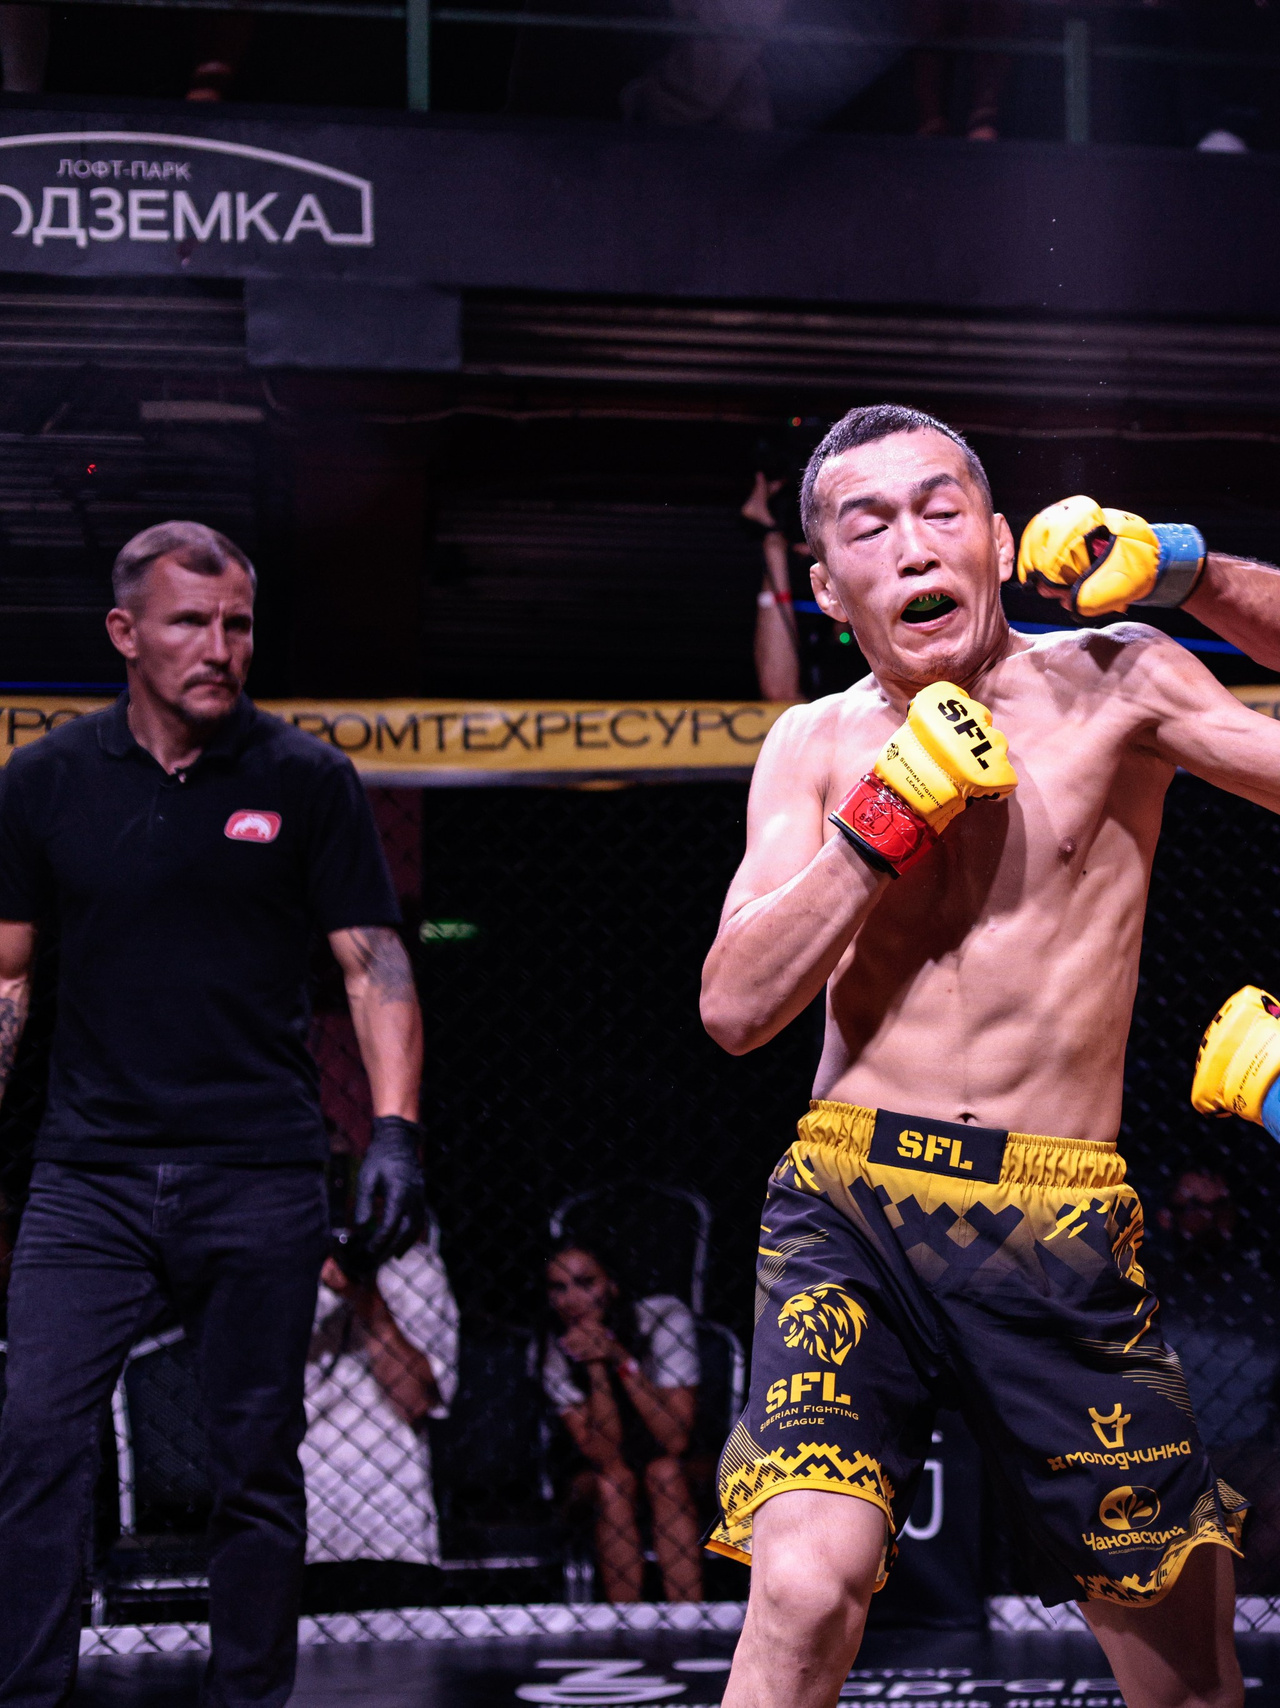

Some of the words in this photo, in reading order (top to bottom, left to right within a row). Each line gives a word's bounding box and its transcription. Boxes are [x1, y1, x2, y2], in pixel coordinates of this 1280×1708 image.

[56, 159, 192, 181] ЛОФТ-ПАРК
[293, 706, 766, 752] РОМТЕХРЕСУРС
[937, 699, 993, 771] SFL
[897, 1129, 974, 1171] SFL
[765, 1371, 851, 1414] SFL
